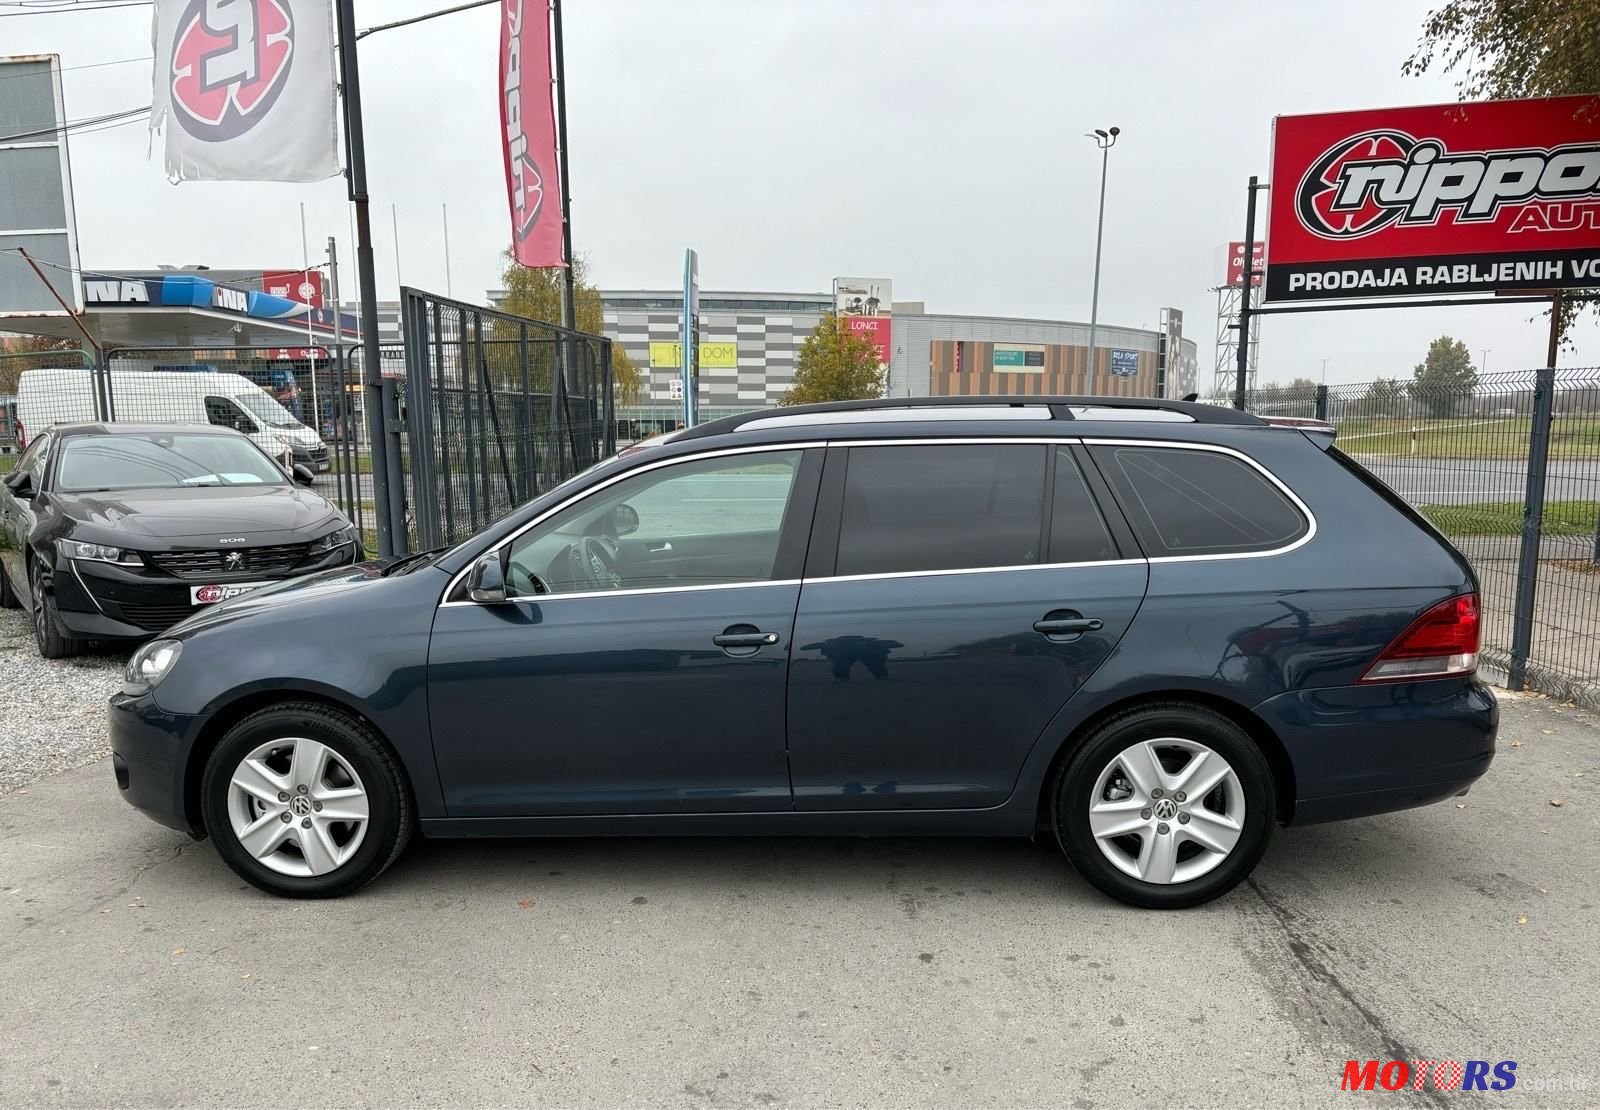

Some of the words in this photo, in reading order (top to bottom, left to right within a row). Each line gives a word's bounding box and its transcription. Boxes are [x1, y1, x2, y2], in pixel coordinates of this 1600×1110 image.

[1333, 142, 1600, 223] nippo
[1288, 267, 1409, 292] PRODAJA
[1415, 260, 1564, 285] RABLJENIH
[851, 321, 878, 330] LONCI
[703, 347, 733, 358] DOM
